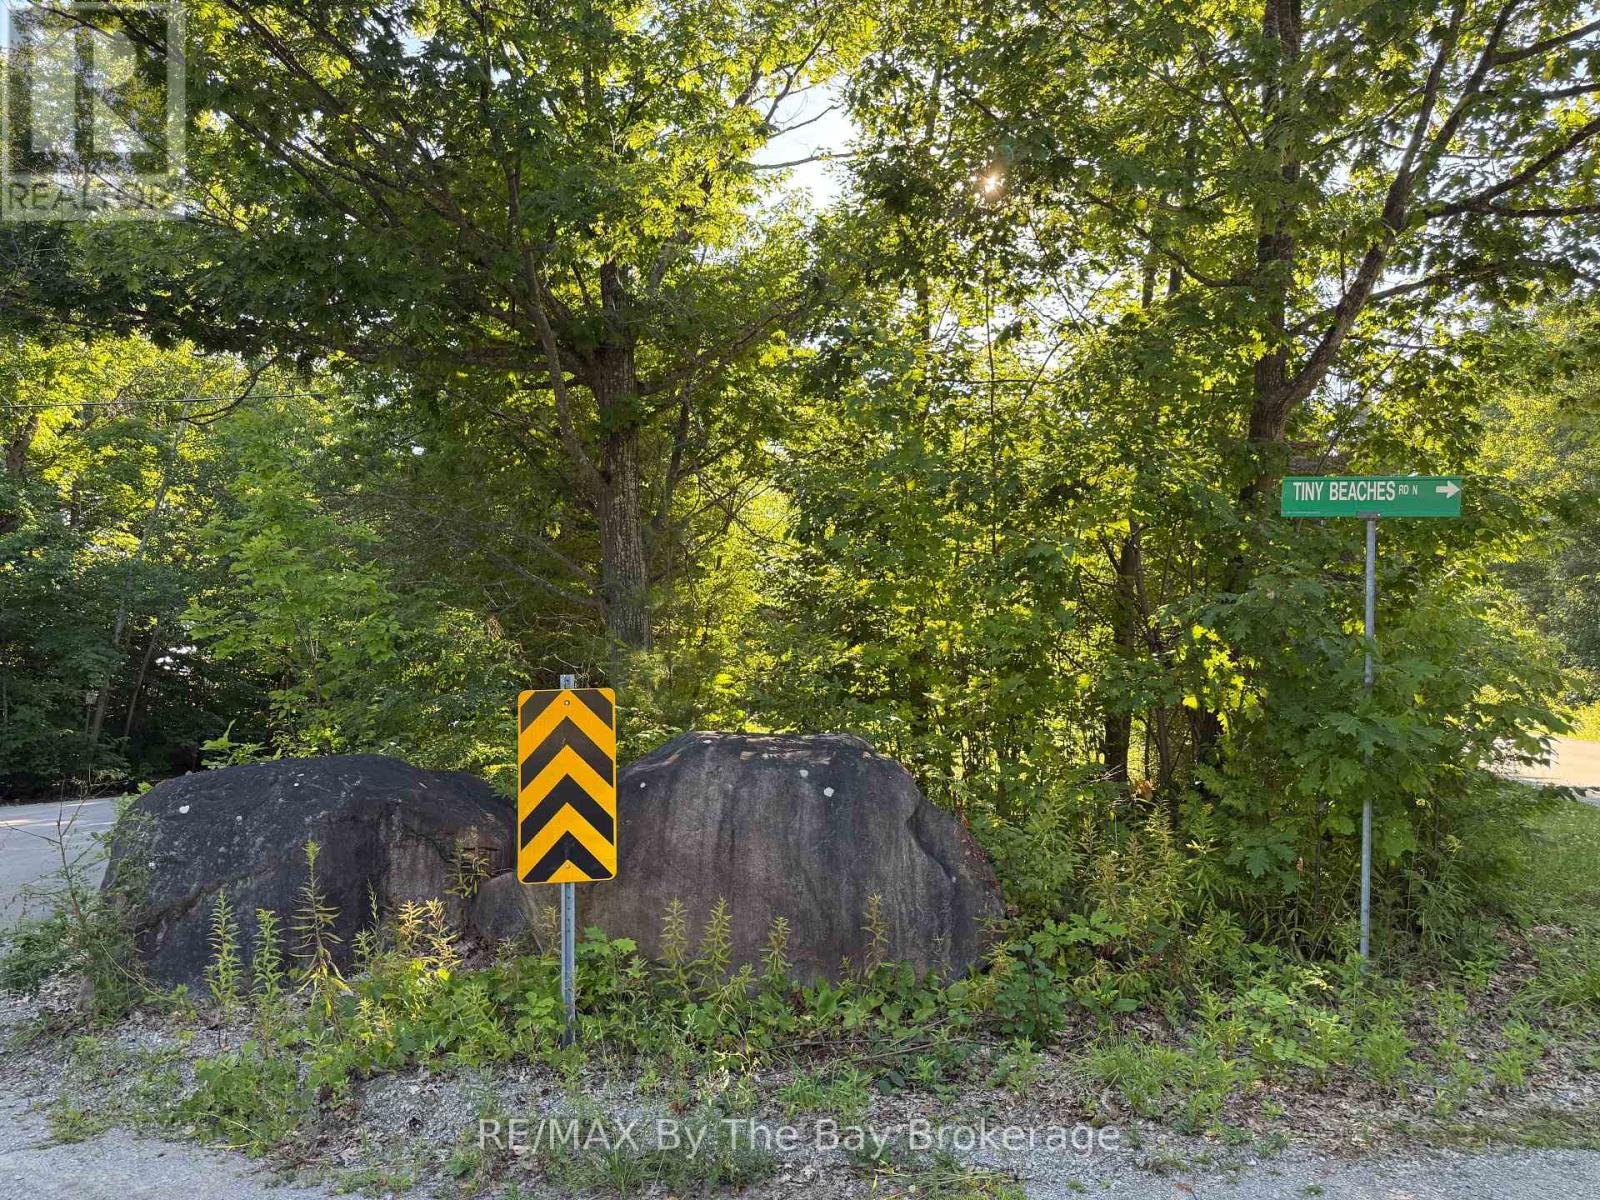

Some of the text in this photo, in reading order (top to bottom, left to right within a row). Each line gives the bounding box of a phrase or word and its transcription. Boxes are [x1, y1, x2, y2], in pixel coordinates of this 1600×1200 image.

[1293, 481, 1418, 501] TINY BEACHES RD N
